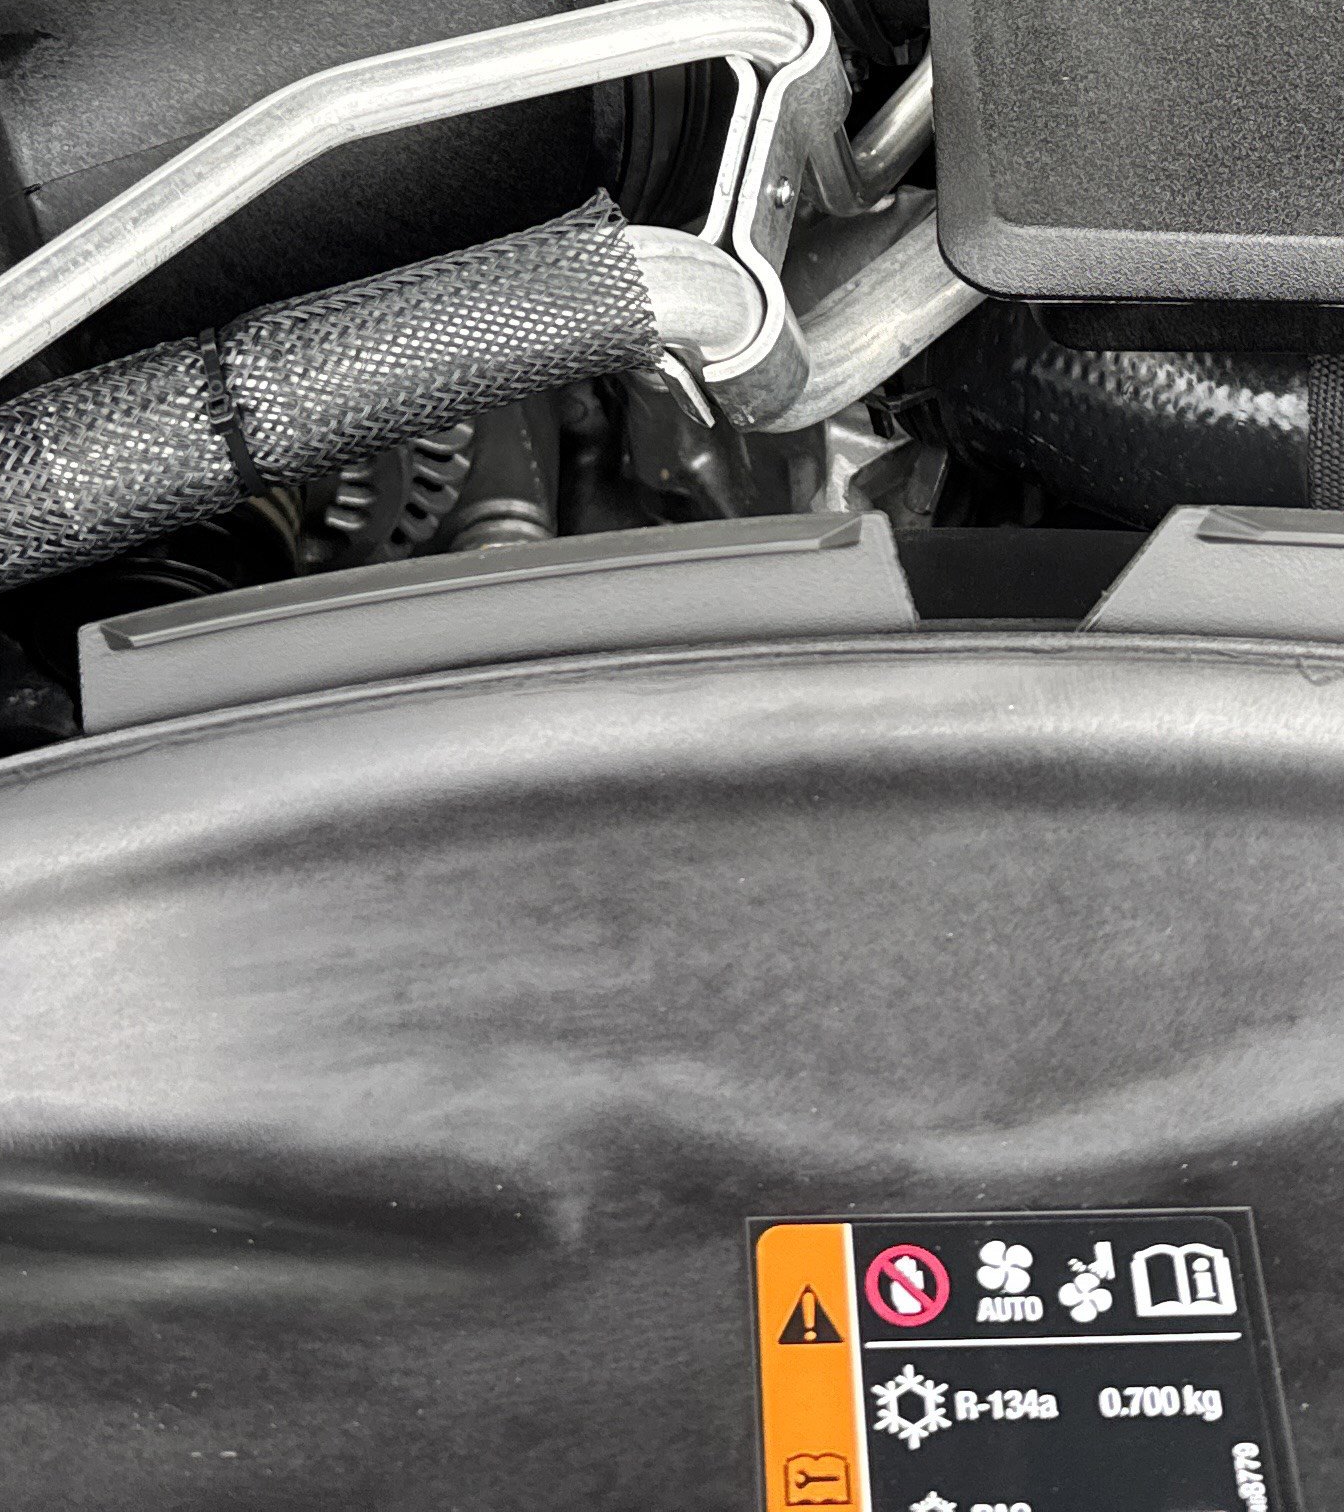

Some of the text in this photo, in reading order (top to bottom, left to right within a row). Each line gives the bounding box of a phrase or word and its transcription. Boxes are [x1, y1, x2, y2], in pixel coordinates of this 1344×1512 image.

[976, 1295, 1044, 1323] AUTO
[954, 1384, 1224, 1422] R-134a 0.700 kg
